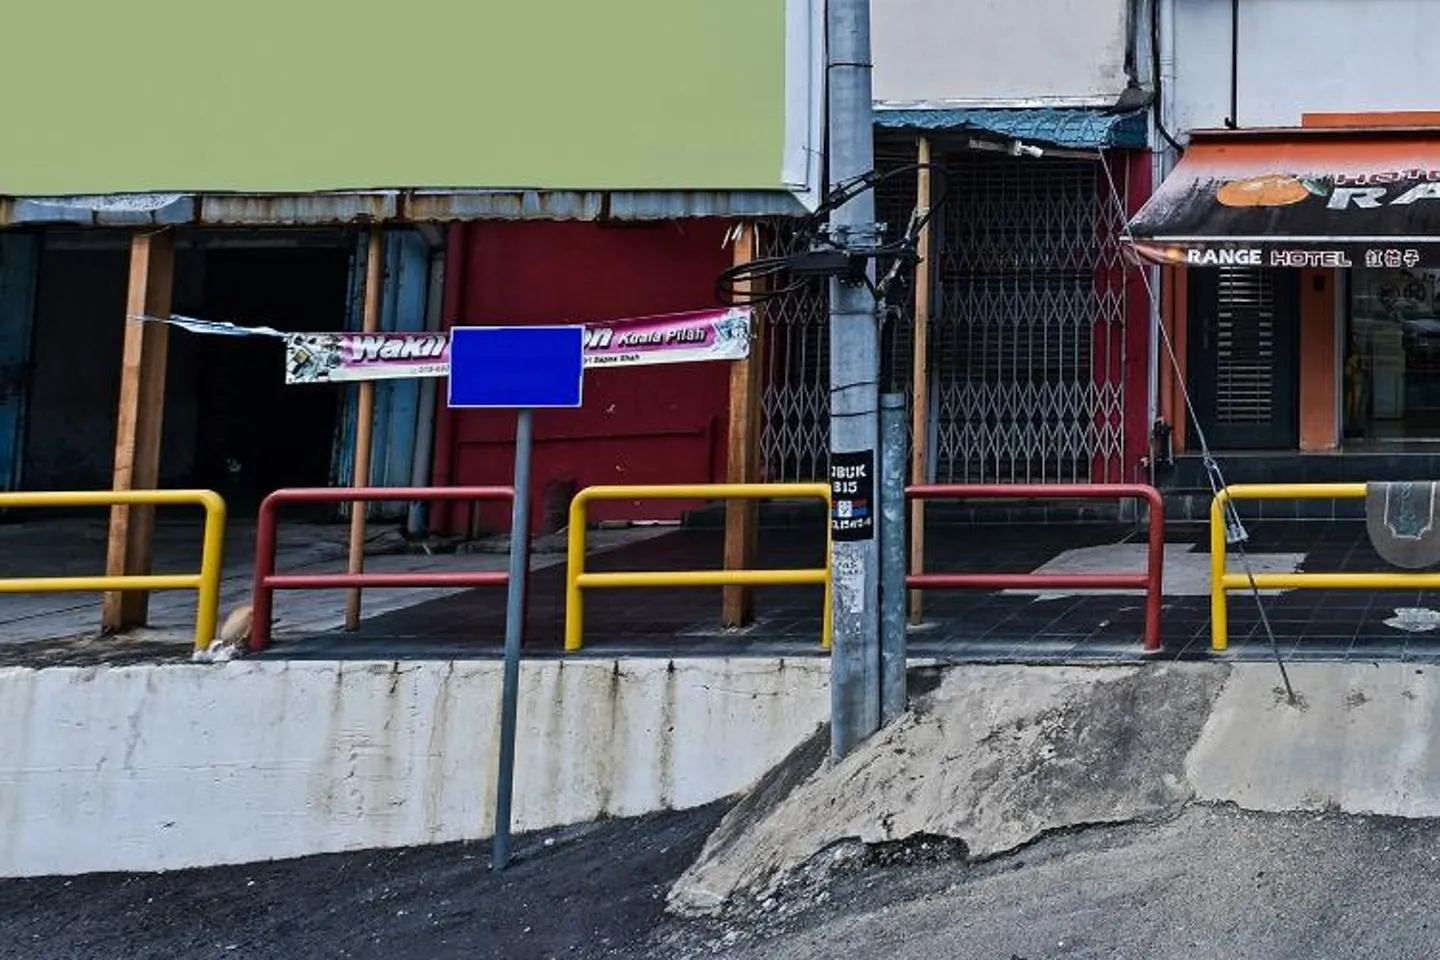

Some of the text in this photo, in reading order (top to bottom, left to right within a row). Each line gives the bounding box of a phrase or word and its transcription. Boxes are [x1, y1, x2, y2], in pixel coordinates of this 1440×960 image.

[1186, 248, 1353, 269] RANGE HOTEL
[351, 335, 446, 361] Wakil
[618, 331, 662, 346] Kuala
[666, 327, 706, 343] Pilah
